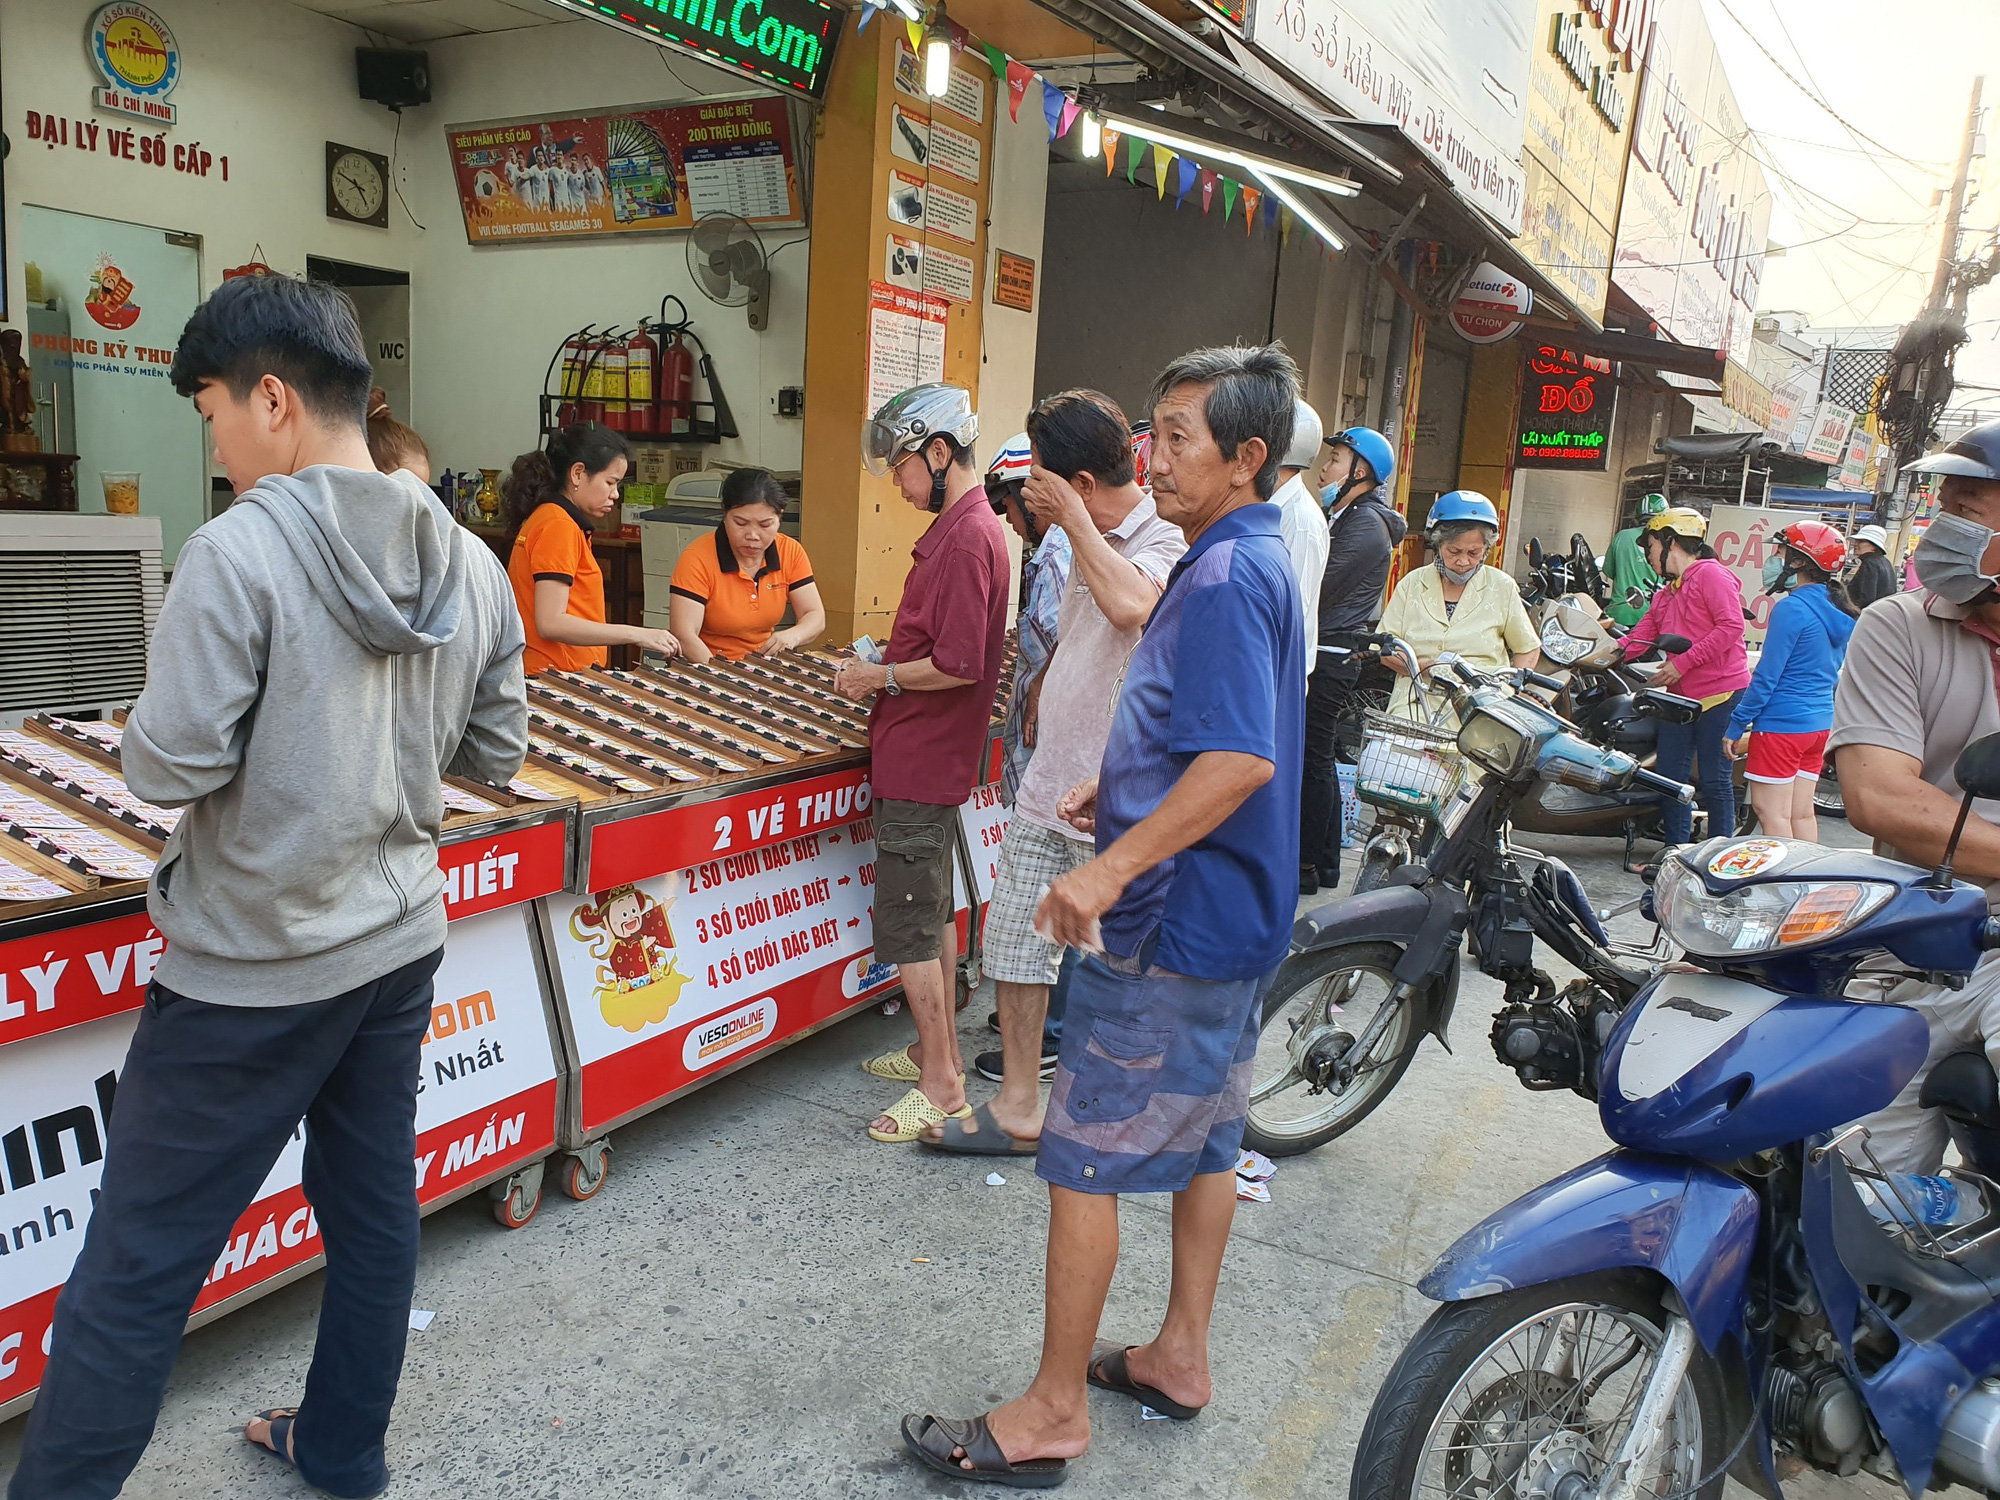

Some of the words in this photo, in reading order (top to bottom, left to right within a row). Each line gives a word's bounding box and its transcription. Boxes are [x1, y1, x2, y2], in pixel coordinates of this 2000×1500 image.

[111, 4, 124, 18] SỐ
[105, 90, 119, 108] HỒ
[123, 96, 140, 113] CHÍ
[144, 101, 171, 120] MINH
[735, 102, 754, 117] BIỆT
[1311, 14, 1338, 68] số
[1343, 36, 1383, 105] kiểu
[1387, 73, 1412, 132] Mỹ
[1422, 105, 1445, 153] Dễ
[1446, 127, 1481, 191] trúng
[1482, 156, 1504, 202] tiền
[1507, 175, 1520, 220] Tỷ
[26, 110, 67, 151] ĐẠI
[75, 118, 99, 152] LÝ
[107, 125, 136, 161] VÉ
[140, 132, 167, 168] SỐ
[173, 141, 212, 178] CẤP
[220, 155, 230, 182] 1
[688, 127, 708, 143] 200
[709, 121, 740, 142] TRIỆU
[742, 118, 773, 137] ĐỒNG
[512, 221, 549, 235] FOOTBALL
[550, 218, 591, 232] SEAGAMES
[592, 218, 602, 229] 30
[1467, 280, 1502, 292] etlott
[1461, 315, 1475, 327] TỰ
[1475, 317, 1503, 329] CHỌN
[31, 330, 98, 356] PHÒNG
[103, 339, 129, 360] KỸ
[134, 346, 174, 365] THU
[379, 342, 405, 361] WC
[54, 357, 90, 371] KHÔNG
[92, 361, 120, 375] PHẬN
[123, 365, 137, 377] SỰ
[1522, 430, 1539, 445] LÃI
[1540, 429, 1572, 446] XUẤT
[1573, 430, 1604, 447] THẤP
[1713, 517, 1779, 570] CẦ
[712, 815, 733, 851] 2
[747, 796, 785, 841] VÉ
[797, 774, 873, 828] THƯỞ
[973, 791, 982, 811] 2
[981, 828, 990, 848] 3
[990, 818, 1002, 845] SỐ
[442, 845, 519, 905] HIẾT
[685, 868, 698, 894] 2
[696, 917, 709, 944] 3
[711, 902, 733, 939] SỐ
[735, 892, 772, 931] CUỐI
[772, 887, 801, 918] ĐẶC
[802, 876, 832, 908] BIỆT
[707, 963, 719, 991] 4
[720, 947, 743, 985] SỐ
[744, 936, 781, 976] CUỐI
[781, 930, 811, 961] ĐẶC
[811, 917, 840, 950] BIỆT
[0, 950, 70, 1022] LÝ
[84, 928, 164, 996] VÉ
[698, 1007, 765, 1047] VESOONLINE
[434, 1037, 505, 1086] Nhất
[440, 1112, 526, 1179] MẮN
[202, 1204, 321, 1288] HÁC
